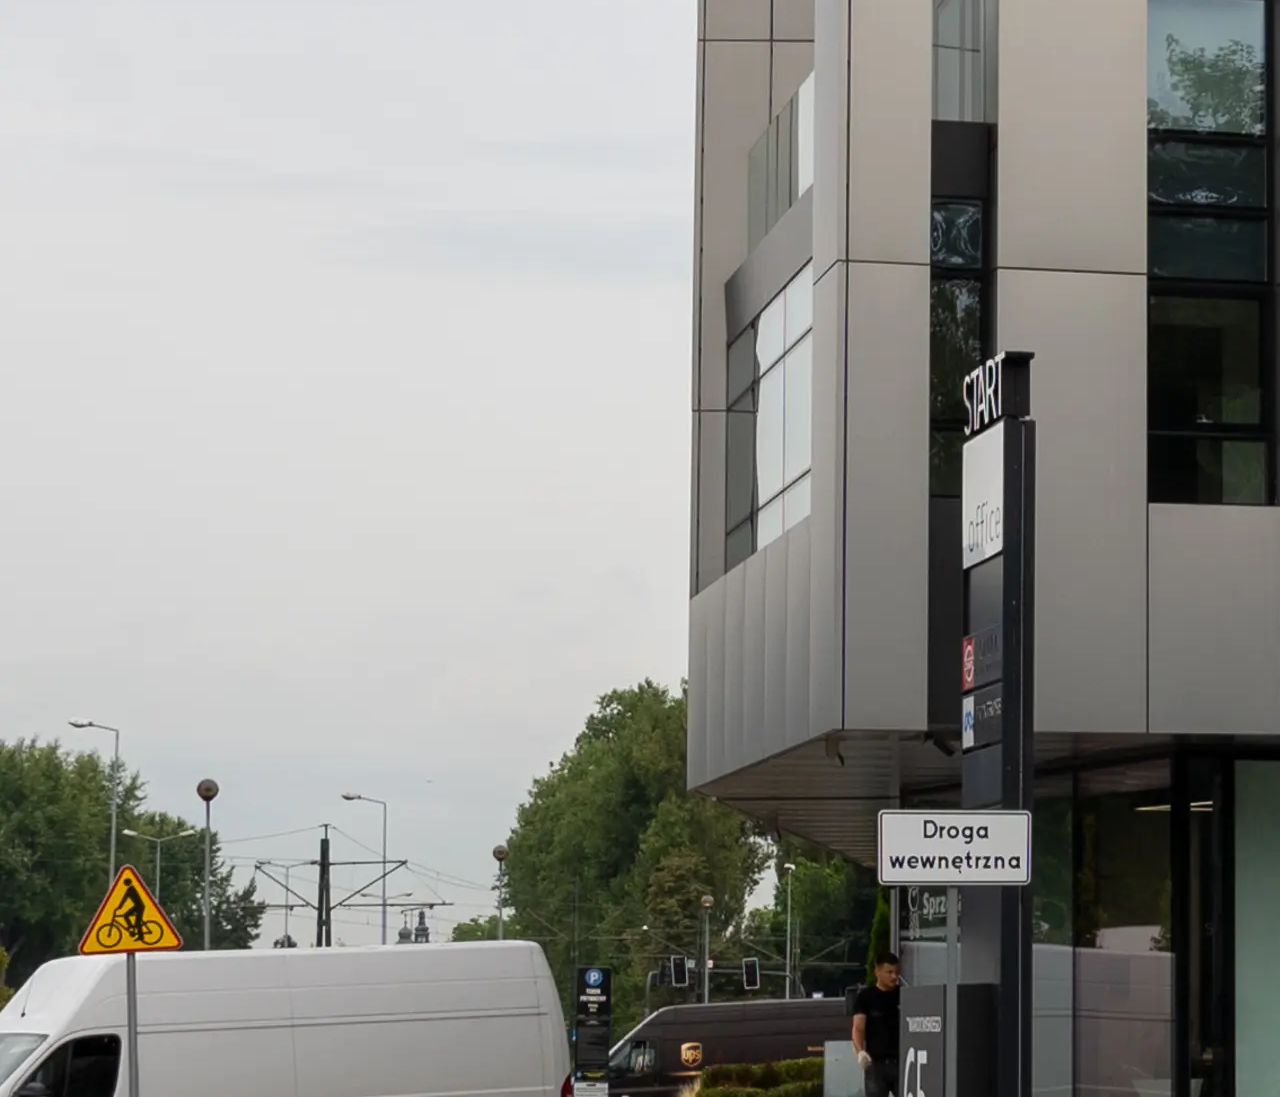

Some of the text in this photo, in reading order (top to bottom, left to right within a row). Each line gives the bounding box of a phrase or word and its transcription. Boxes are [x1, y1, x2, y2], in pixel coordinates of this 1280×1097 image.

[963, 350, 1006, 437] START
[968, 500, 1002, 554] office
[923, 819, 989, 845] Droga
[889, 850, 1021, 874] wewnętrzna
